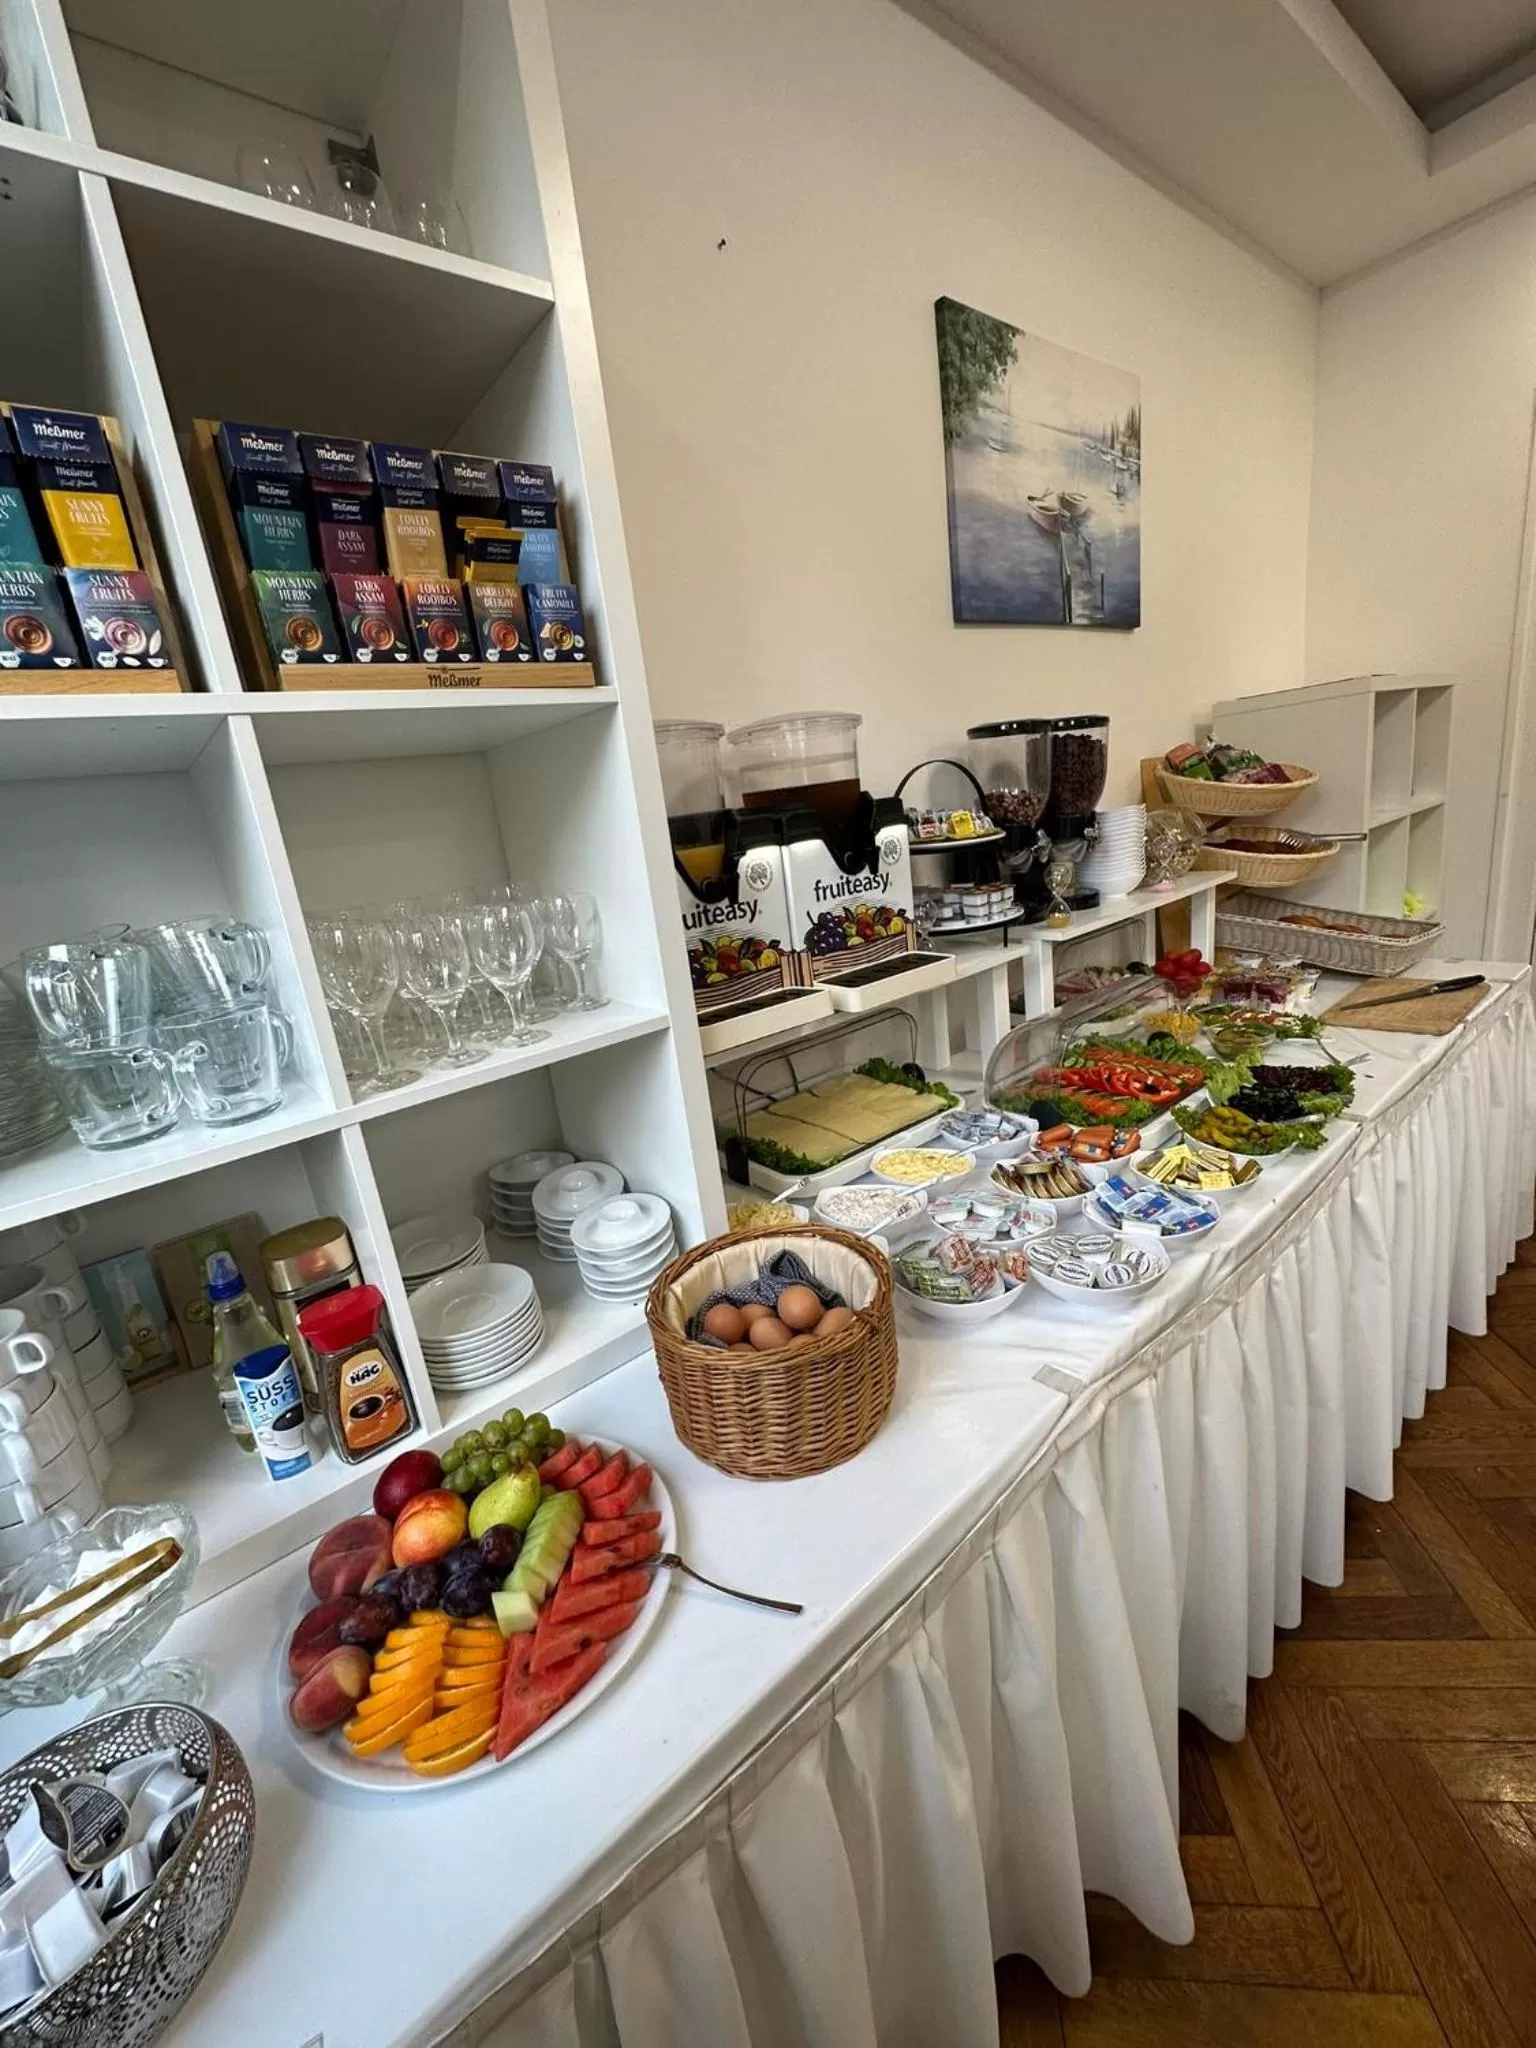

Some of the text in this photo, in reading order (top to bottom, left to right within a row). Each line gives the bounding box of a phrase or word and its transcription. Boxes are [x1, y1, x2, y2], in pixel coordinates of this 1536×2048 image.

[32, 422, 87, 440] Meßmer
[240, 437, 284, 452] Meßmer
[316, 448, 355, 463] Meßmer
[386, 455, 423, 470] Meßmer
[453, 466, 487, 480] Meßmer
[513, 473, 545, 486] Meßmer
[89, 575, 130, 588] SUNNY
[264, 576, 318, 590] MOUNTAIN
[354, 579, 381, 592] DARK
[91, 587, 136, 601] FRUITS
[278, 588, 312, 601] HERBS
[355, 590, 386, 603] ASSAM
[427, 673, 483, 688] Meßmer
[813, 871, 890, 903] fruiteasy
[682, 899, 759, 931] uiteasy
[350, 1363, 380, 1385] HAG
